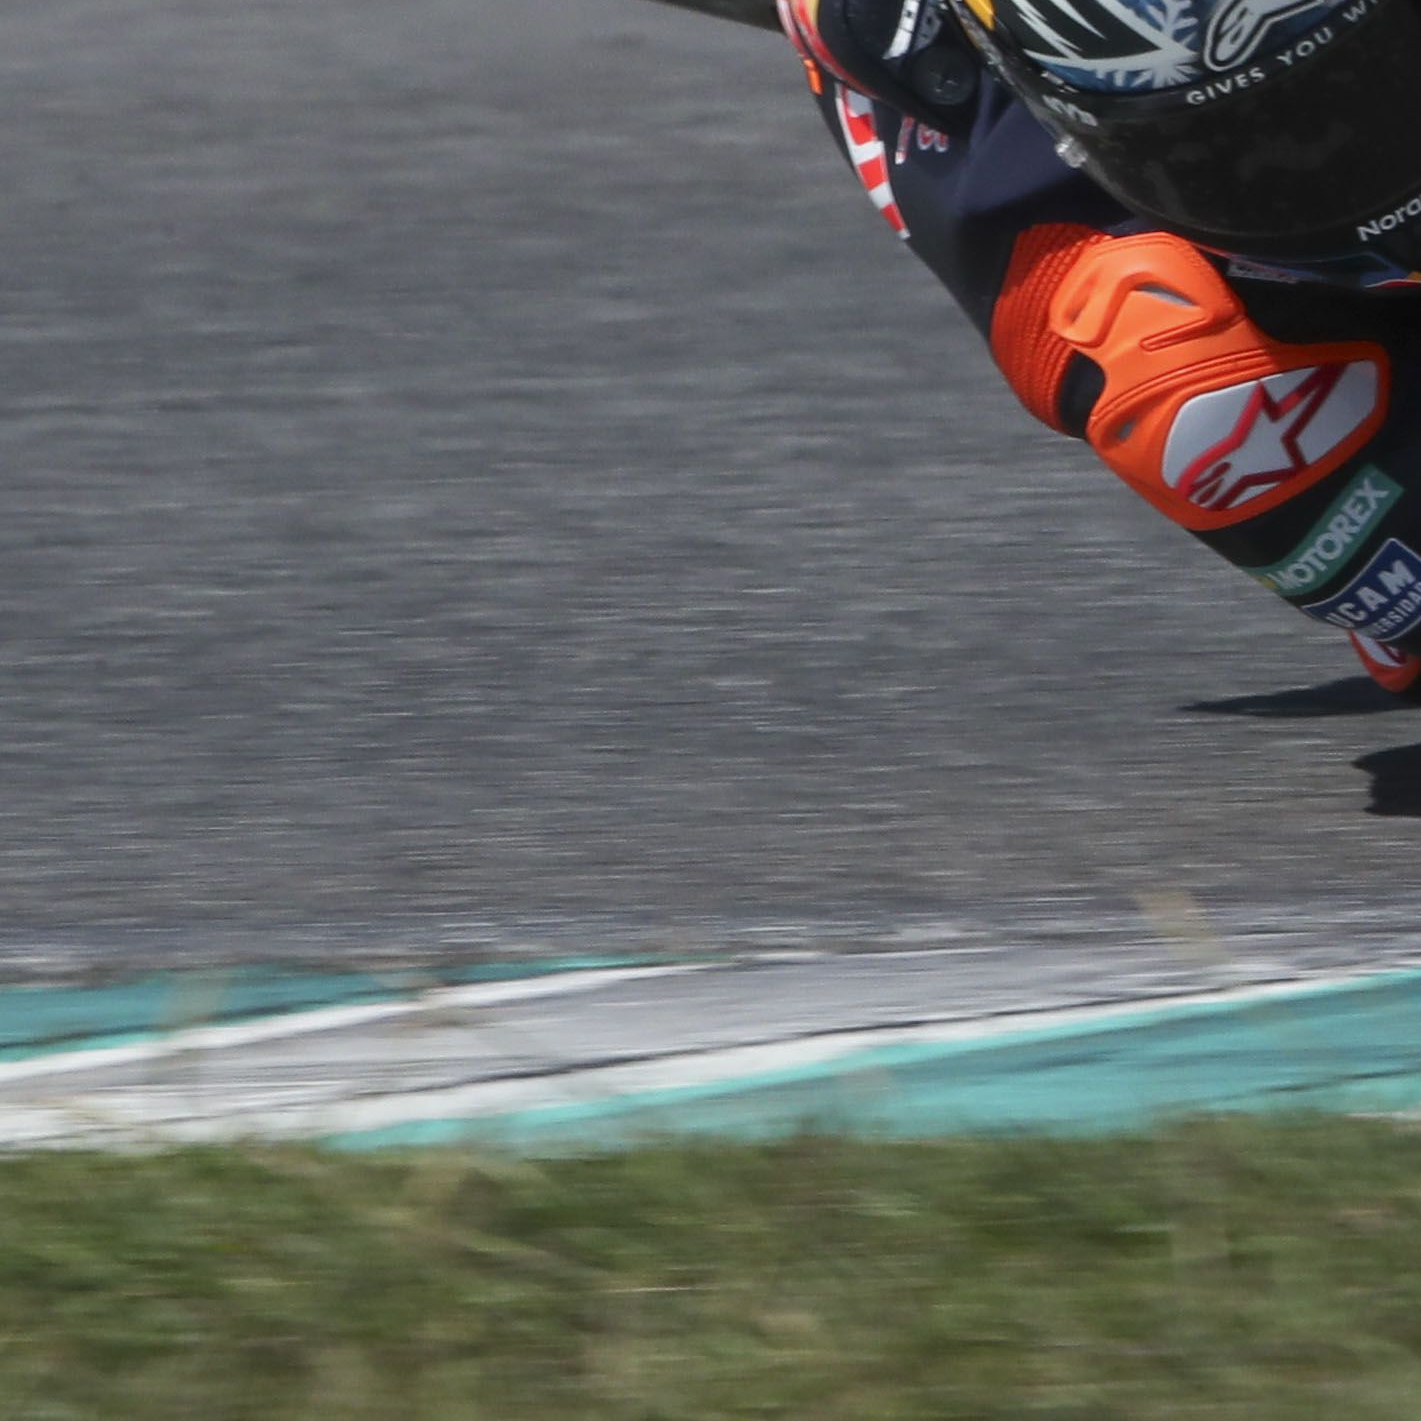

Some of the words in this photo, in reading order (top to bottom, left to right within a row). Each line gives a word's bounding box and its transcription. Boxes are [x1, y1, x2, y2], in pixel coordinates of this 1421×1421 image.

[1186, 67, 1266, 105] GIVES
[1277, 27, 1333, 66] YOU
[1267, 478, 1390, 590] MOTOREX
[1325, 559, 1417, 628] UCAM
